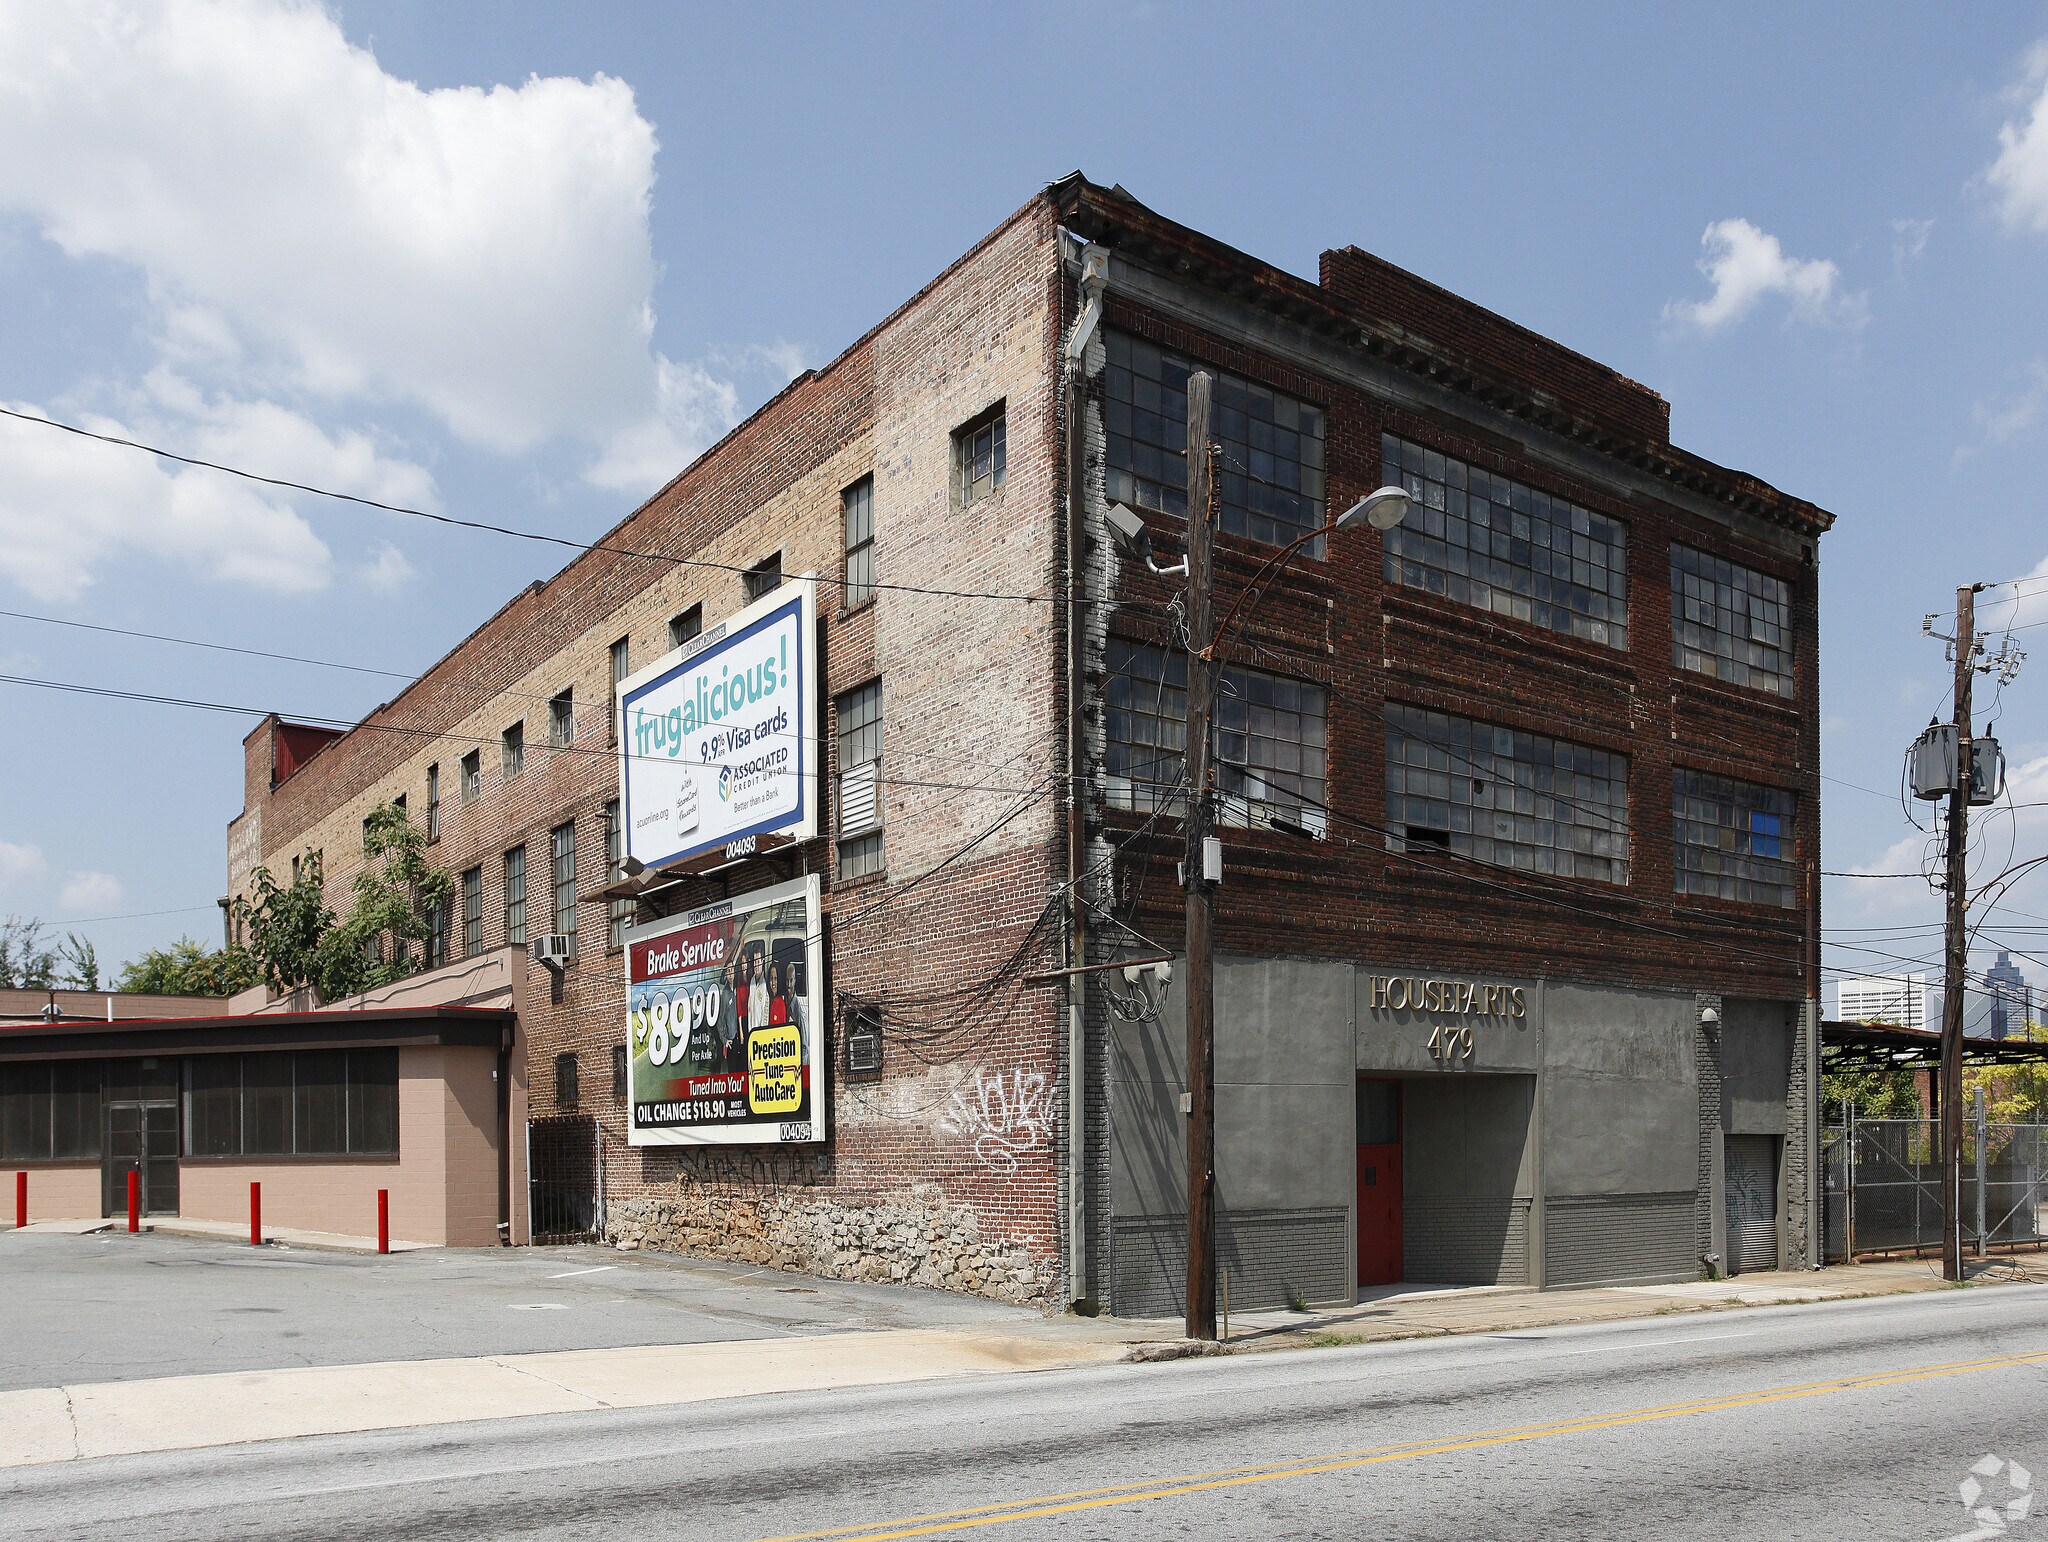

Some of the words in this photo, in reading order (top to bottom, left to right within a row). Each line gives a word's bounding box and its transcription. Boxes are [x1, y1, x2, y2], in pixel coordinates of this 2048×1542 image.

[635, 634, 787, 758] frugalicious!
[726, 727, 751, 752] Visa
[754, 706, 788, 741] cards
[733, 747, 788, 782] ASSOCIATED
[734, 776, 759, 793] CREDIT
[762, 765, 787, 782] UNION
[734, 801, 749, 813] Better
[750, 795, 761, 807] than
[766, 786, 779, 801] Bank
[726, 835, 756, 859] 004093
[647, 944, 680, 976] Brake
[681, 934, 724, 968] Service
[692, 1034, 702, 1045] And
[702, 1033, 710, 1044] Up
[752, 1037, 796, 1060] Precision
[1421, 1026, 1475, 1060] 479
[691, 1051, 701, 1061] Per
[701, 1050, 712, 1060] Axle
[764, 1062, 784, 1079] Tune
[689, 1077, 710, 1096] Tuned
[711, 1078, 726, 1094] Into
[638, 1105, 653, 1122] OIL
[654, 1101, 692, 1121] CHANGE
[693, 1100, 725, 1121] $18.90
